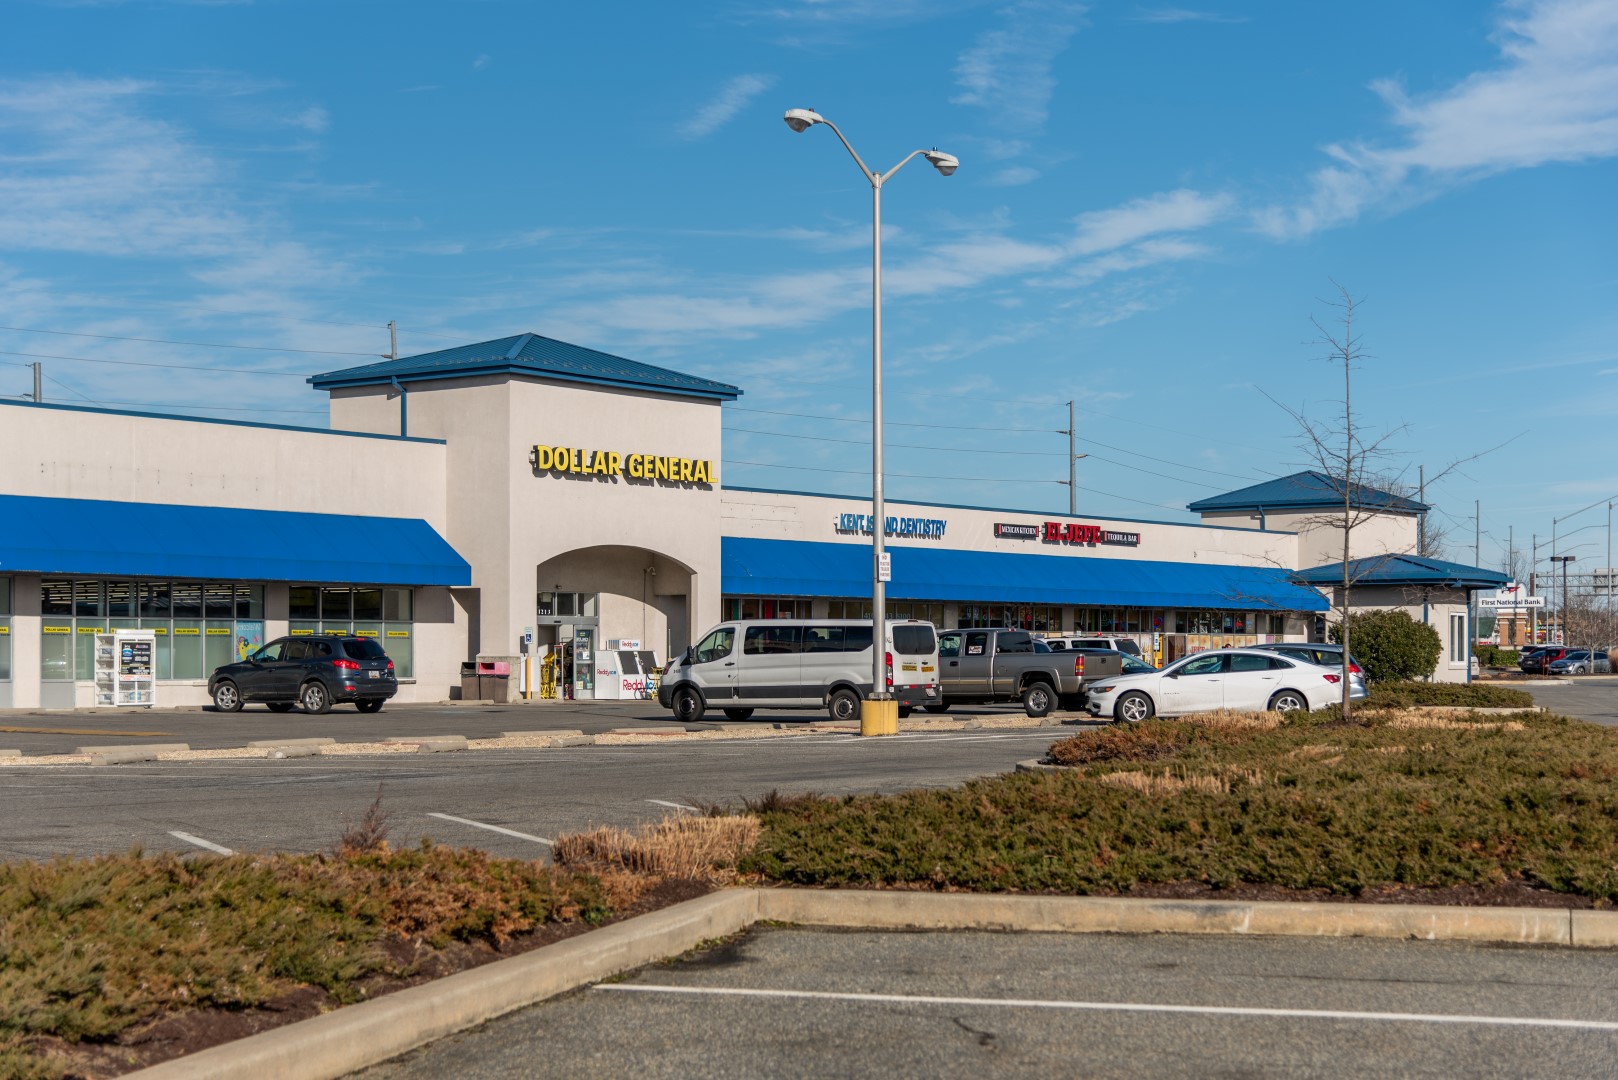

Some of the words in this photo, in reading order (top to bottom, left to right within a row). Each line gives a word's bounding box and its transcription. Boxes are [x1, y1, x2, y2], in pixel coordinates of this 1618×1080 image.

[536, 444, 623, 476] DOLLAR
[628, 453, 718, 483] GENERAL
[840, 513, 865, 531] KENT
[867, 515, 898, 533] ISND
[900, 517, 947, 536] DENTISTRY
[1001, 525, 1019, 534] MEXICAN
[1019, 526, 1037, 535] KITCHEN
[1046, 522, 1065, 541] EL
[1066, 524, 1101, 543] JEFE
[1107, 531, 1127, 541] TEQUILA
[1127, 534, 1138, 542] BAR
